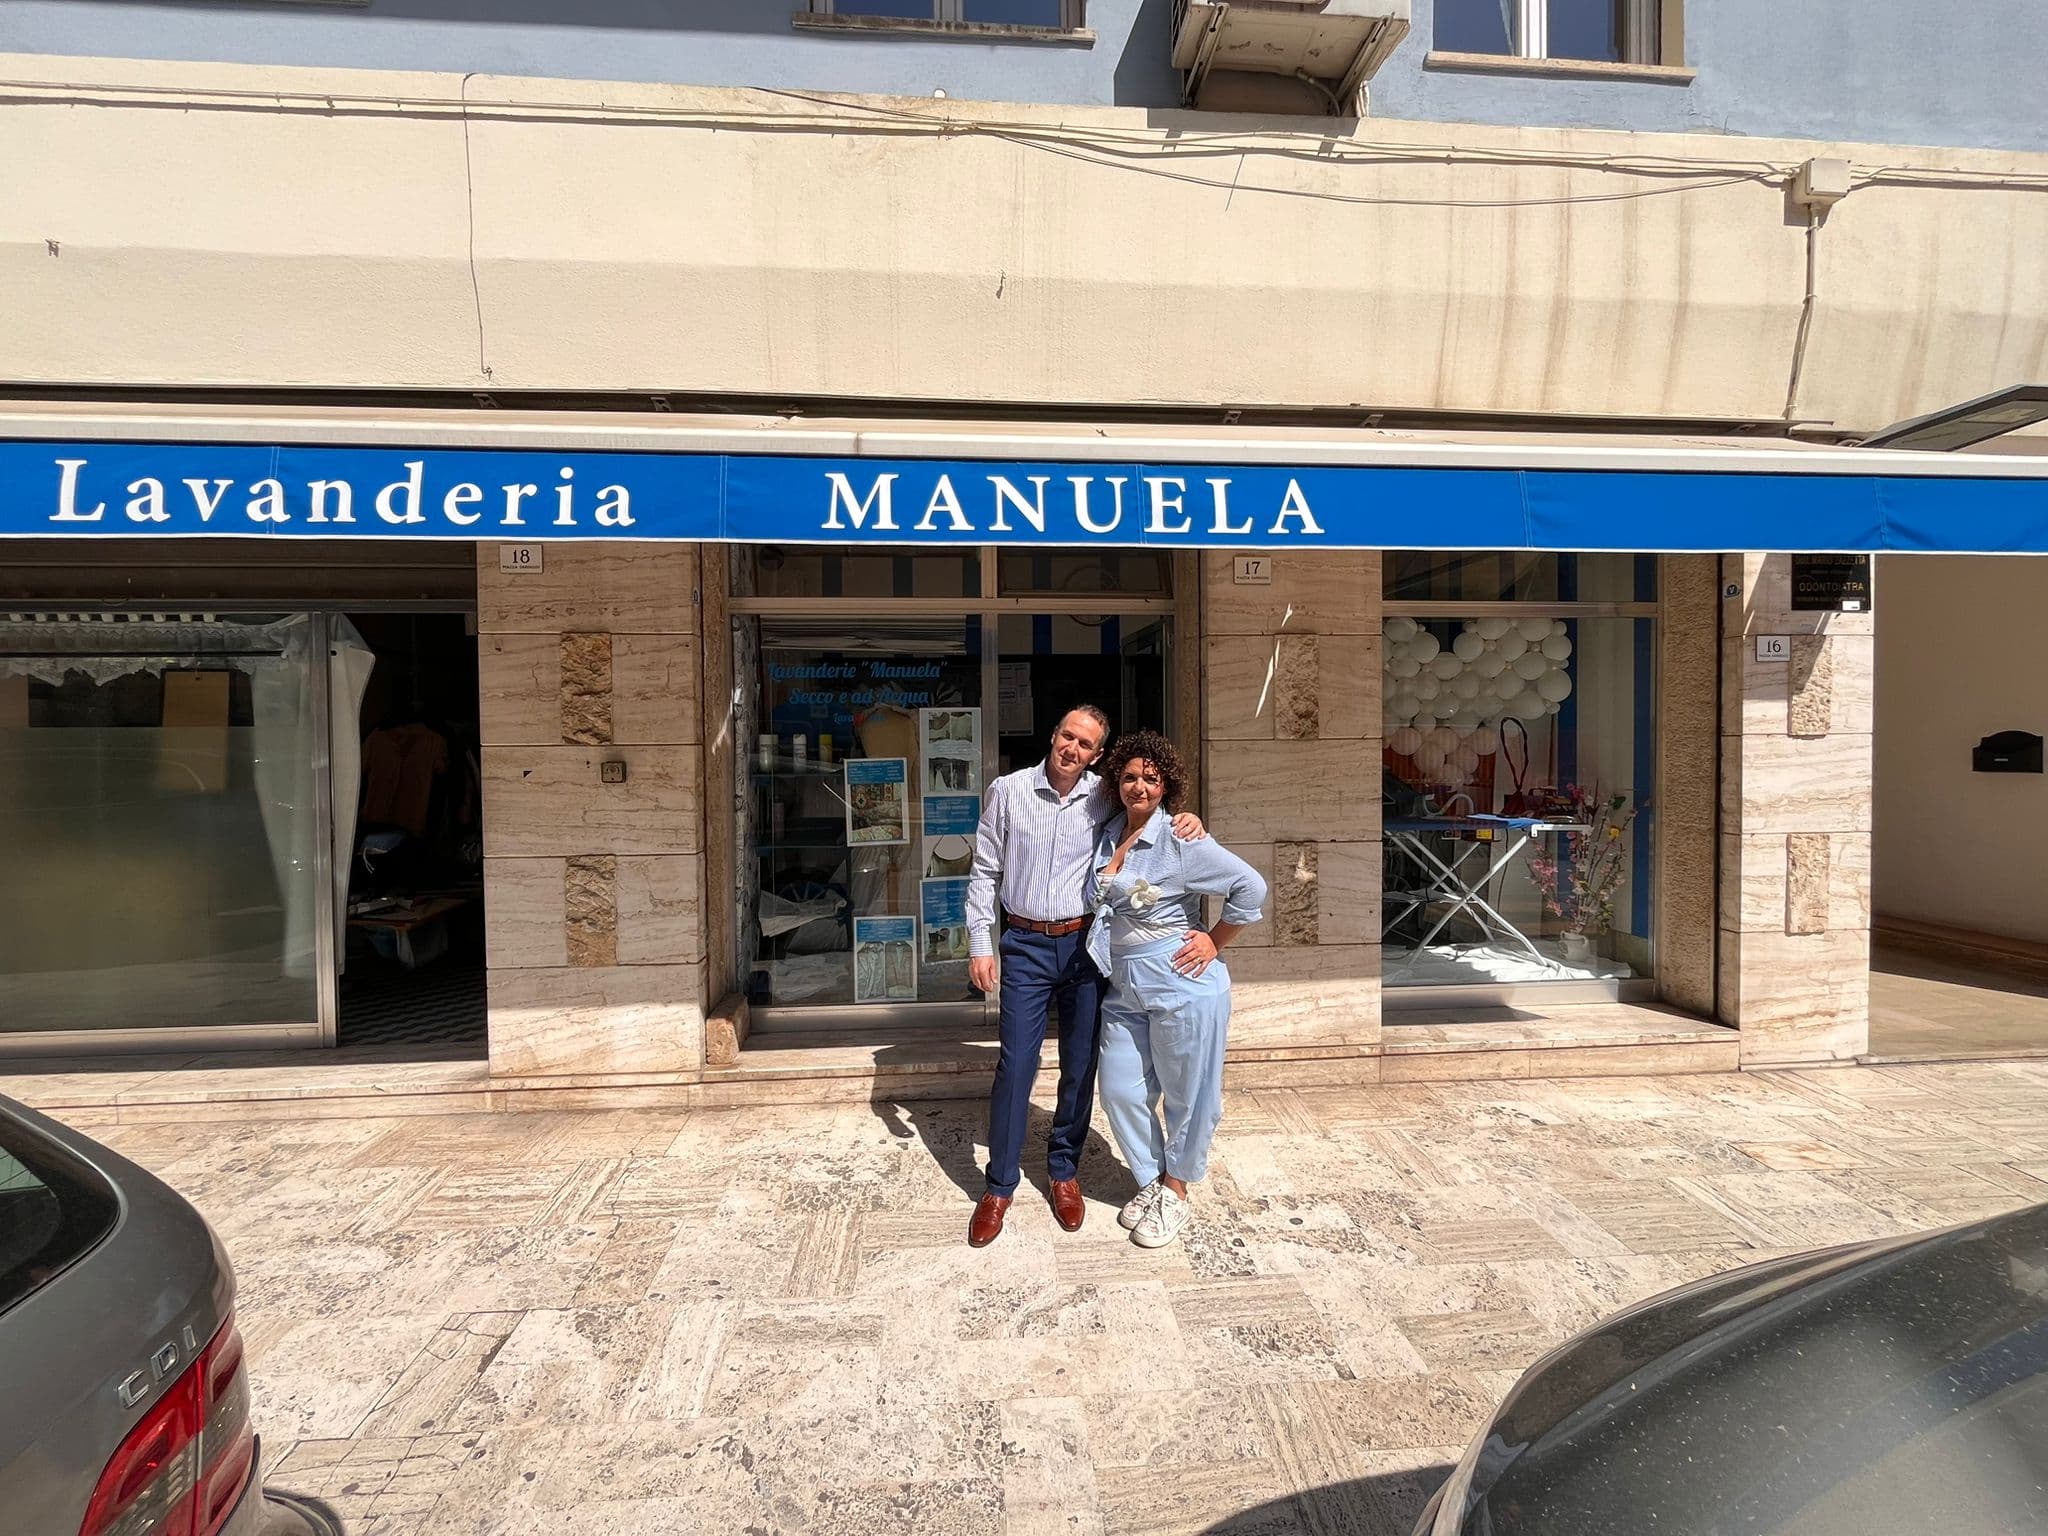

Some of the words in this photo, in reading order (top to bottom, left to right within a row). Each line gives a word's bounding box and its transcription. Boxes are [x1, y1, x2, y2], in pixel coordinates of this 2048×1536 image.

[48, 457, 636, 528] Lavanderia
[820, 472, 1326, 536] MANUELA
[512, 549, 530, 564] 18
[1245, 561, 1261, 575] 17
[1766, 639, 1782, 653] 16
[861, 660, 948, 679] "Manuela"
[789, 687, 834, 705] Secco
[839, 691, 848, 705] e
[849, 688, 873, 705] ad
[118, 1325, 197, 1409] CDI
